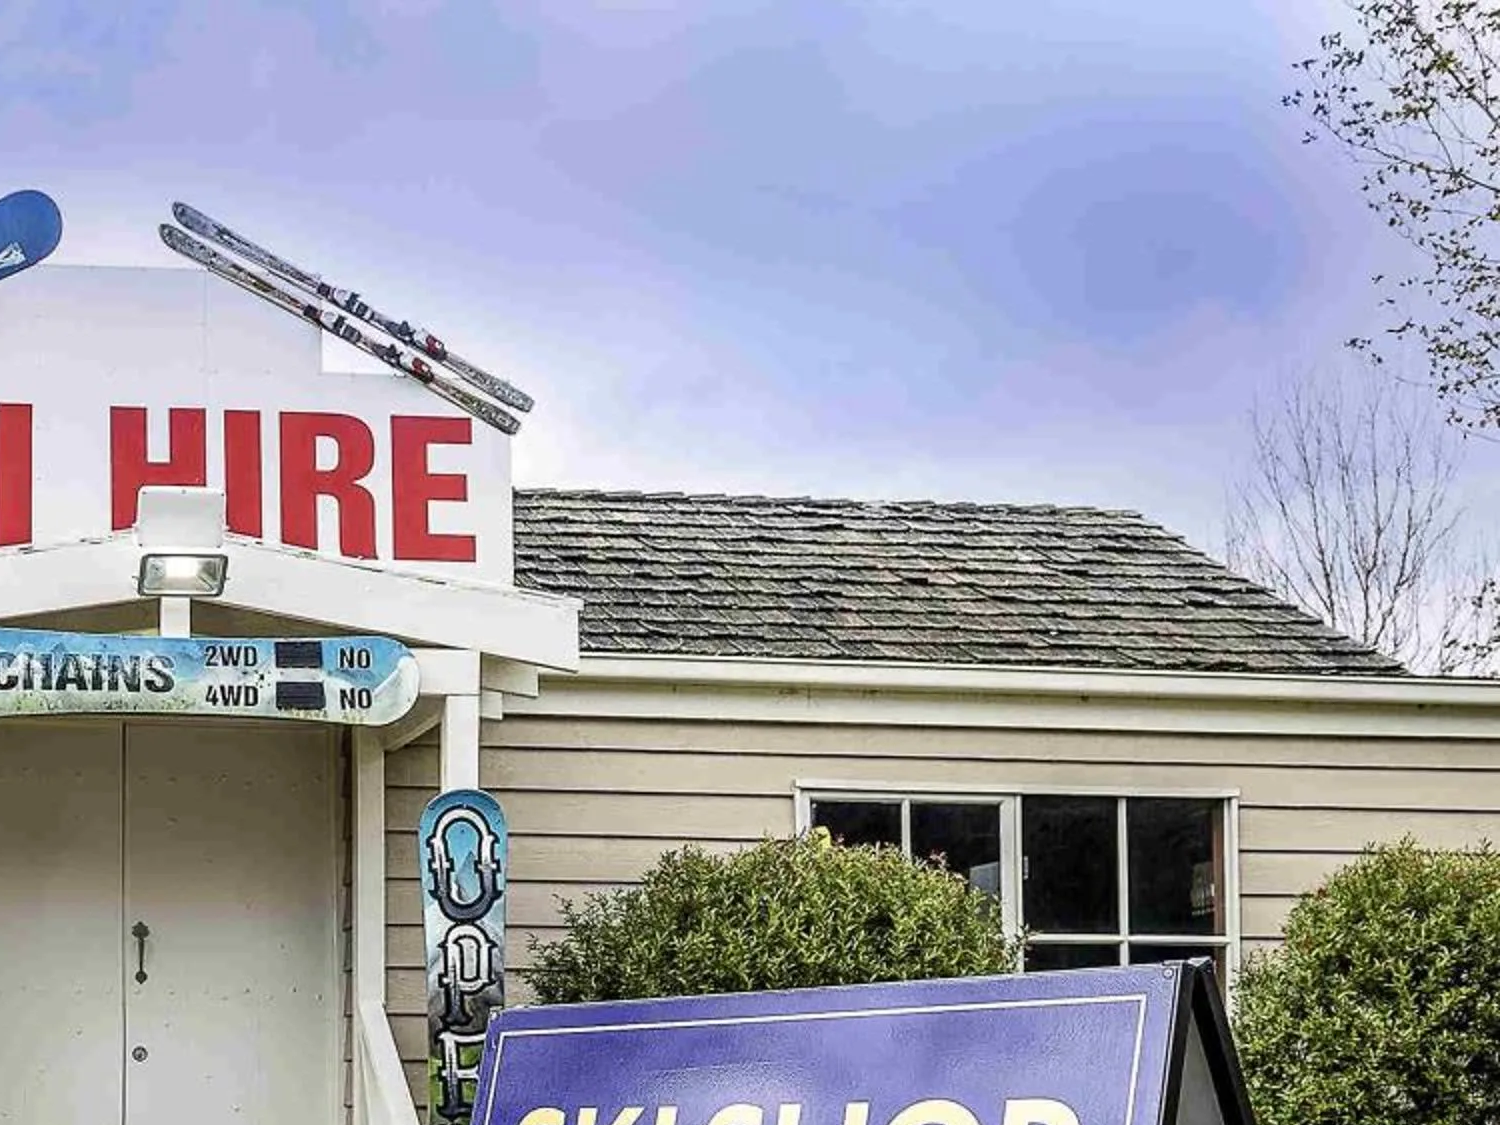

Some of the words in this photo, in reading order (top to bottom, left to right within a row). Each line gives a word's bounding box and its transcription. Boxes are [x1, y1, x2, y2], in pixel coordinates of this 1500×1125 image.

[110, 406, 477, 562] HIRE
[204, 645, 258, 668] 2WD
[339, 647, 371, 669] NO
[205, 685, 259, 708] 4WD
[340, 688, 373, 710] NO
